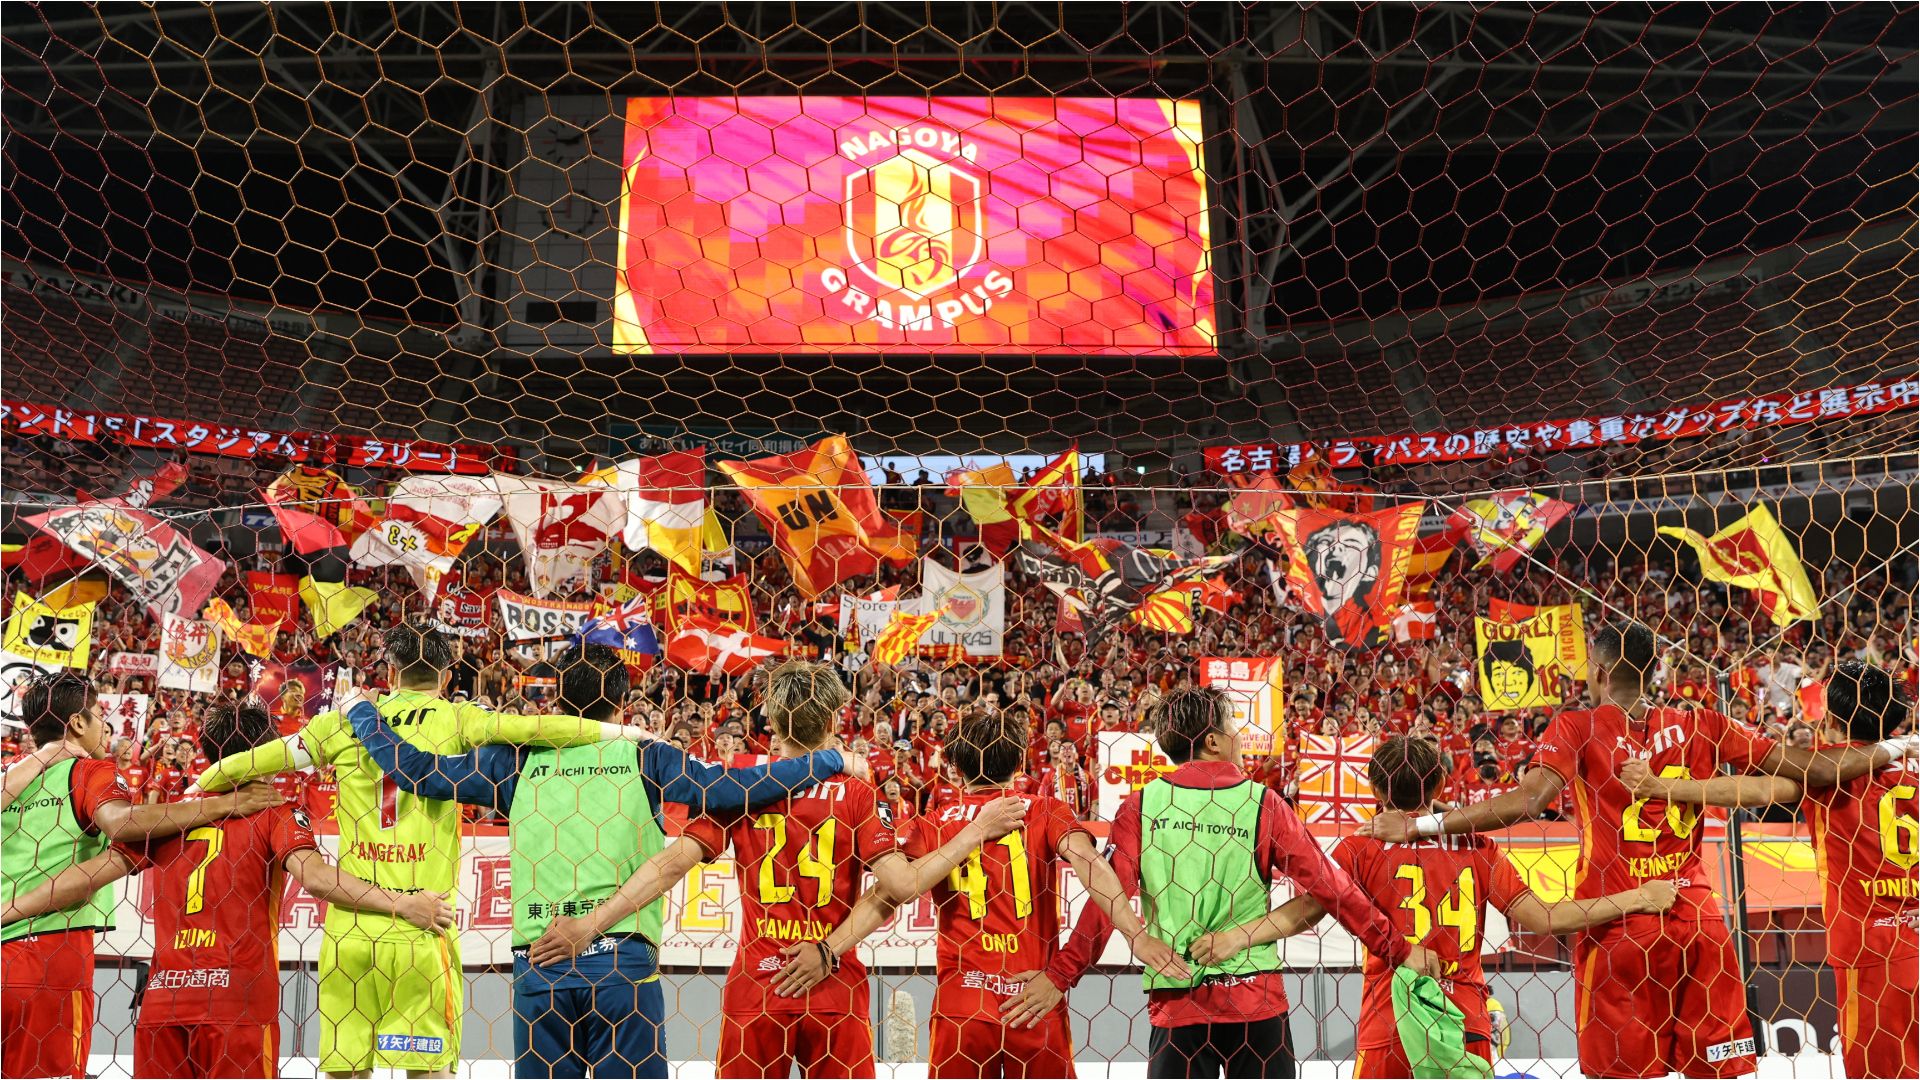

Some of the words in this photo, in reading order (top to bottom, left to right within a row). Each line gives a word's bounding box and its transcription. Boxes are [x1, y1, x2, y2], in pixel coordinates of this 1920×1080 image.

[840, 127, 979, 163] NAGOYA
[21, 272, 139, 304] YAZAKI
[820, 269, 1015, 332] GRAMPUS
[843, 596, 888, 612] Score
[930, 629, 992, 646] ULTRAS
[1482, 612, 1553, 641] GOAL!
[1207, 660, 1250, 680] 森島
[1535, 663, 1562, 698] 18
[1131, 750, 1166, 766] Ha
[529, 764, 550, 779] AT
[553, 766, 587, 777] AICHI
[589, 765, 632, 776] TOYOTA
[1104, 766, 1160, 785] Cha
[1149, 818, 1170, 832] AT
[1172, 821, 1204, 833] AICHI
[1206, 824, 1250, 840] TOYOTA
[350, 840, 427, 864] LANGERAK
[753, 812, 836, 908] 24
[185, 826, 225, 916] 7
[948, 828, 1034, 921] 41
[1393, 863, 1478, 953] 34
[173, 929, 217, 951] IZUMI
[981, 933, 1019, 954] ONO
